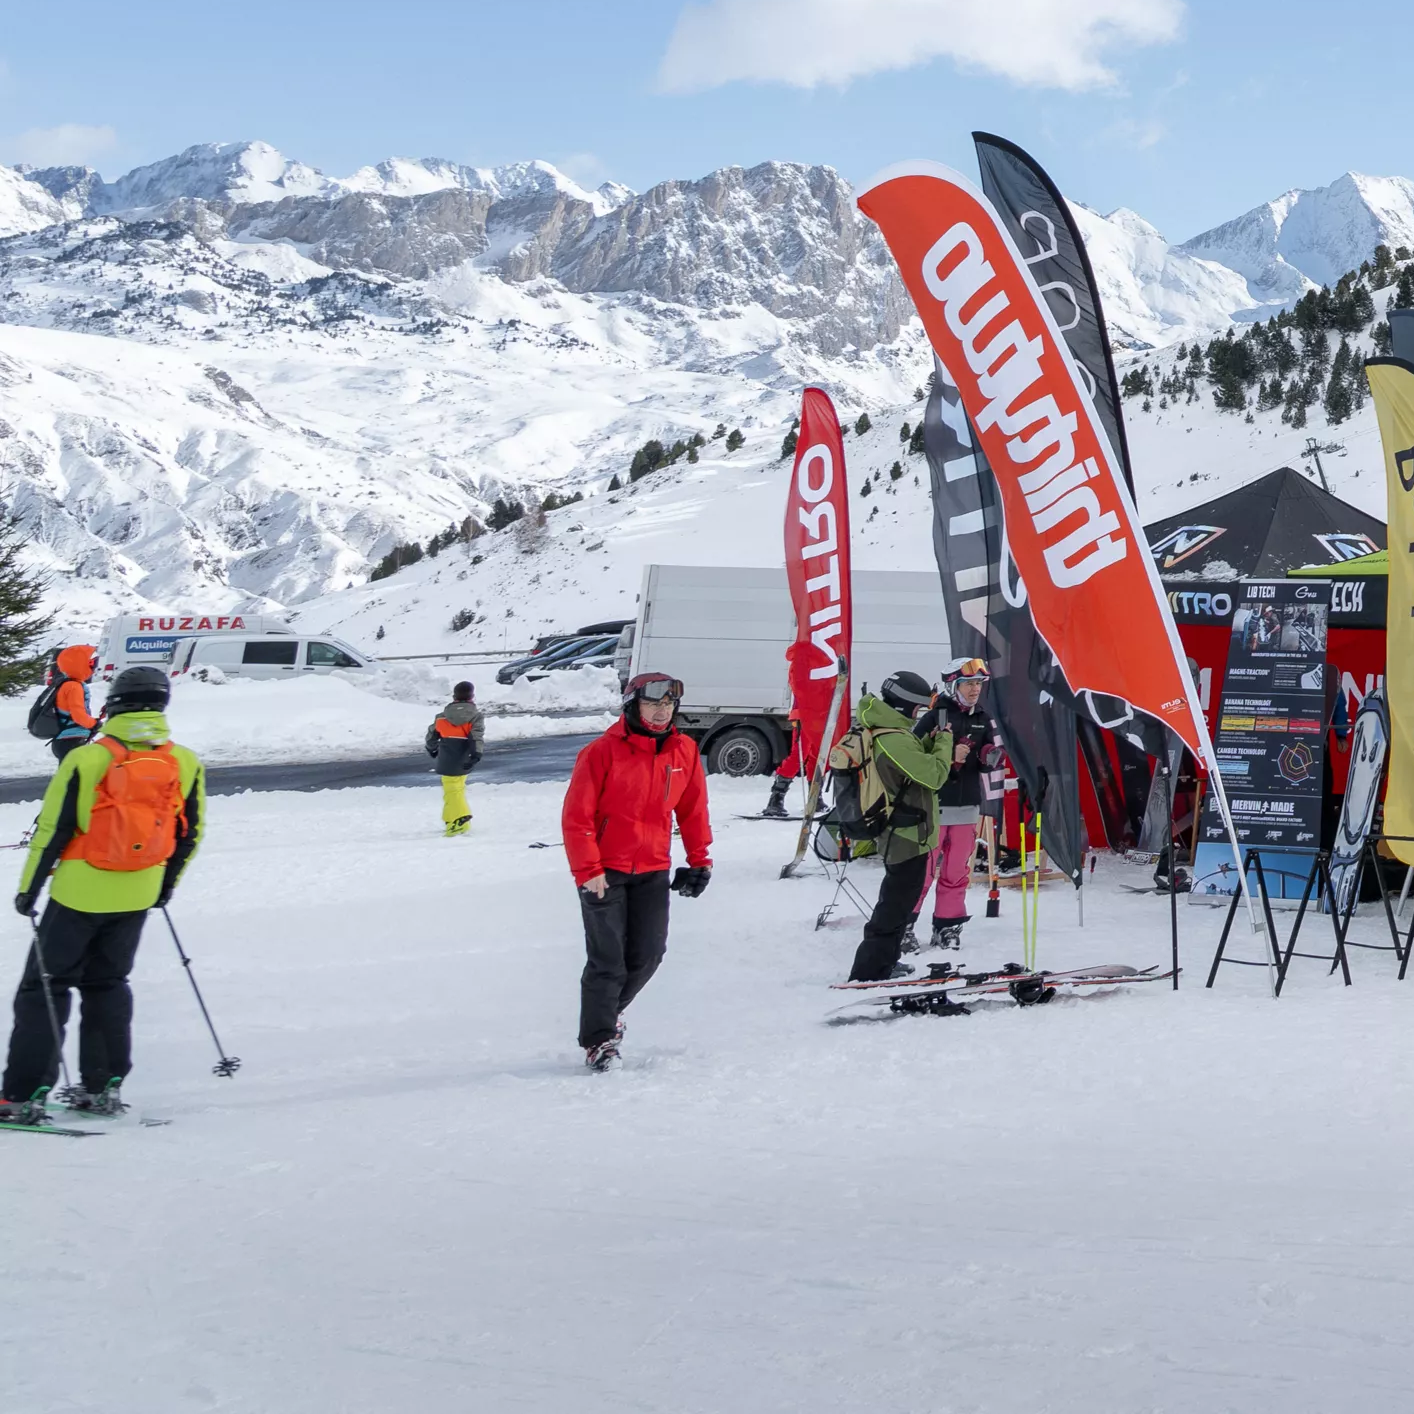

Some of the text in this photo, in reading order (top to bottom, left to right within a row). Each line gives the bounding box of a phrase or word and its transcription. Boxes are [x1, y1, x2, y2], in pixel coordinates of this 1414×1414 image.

[1247, 586, 1258, 597] LIB
[1258, 586, 1276, 598] TECH
[1331, 581, 1366, 613] ECH
[139, 617, 246, 631] RUZAFA
[1231, 799, 1294, 812] MERVIN MADE
